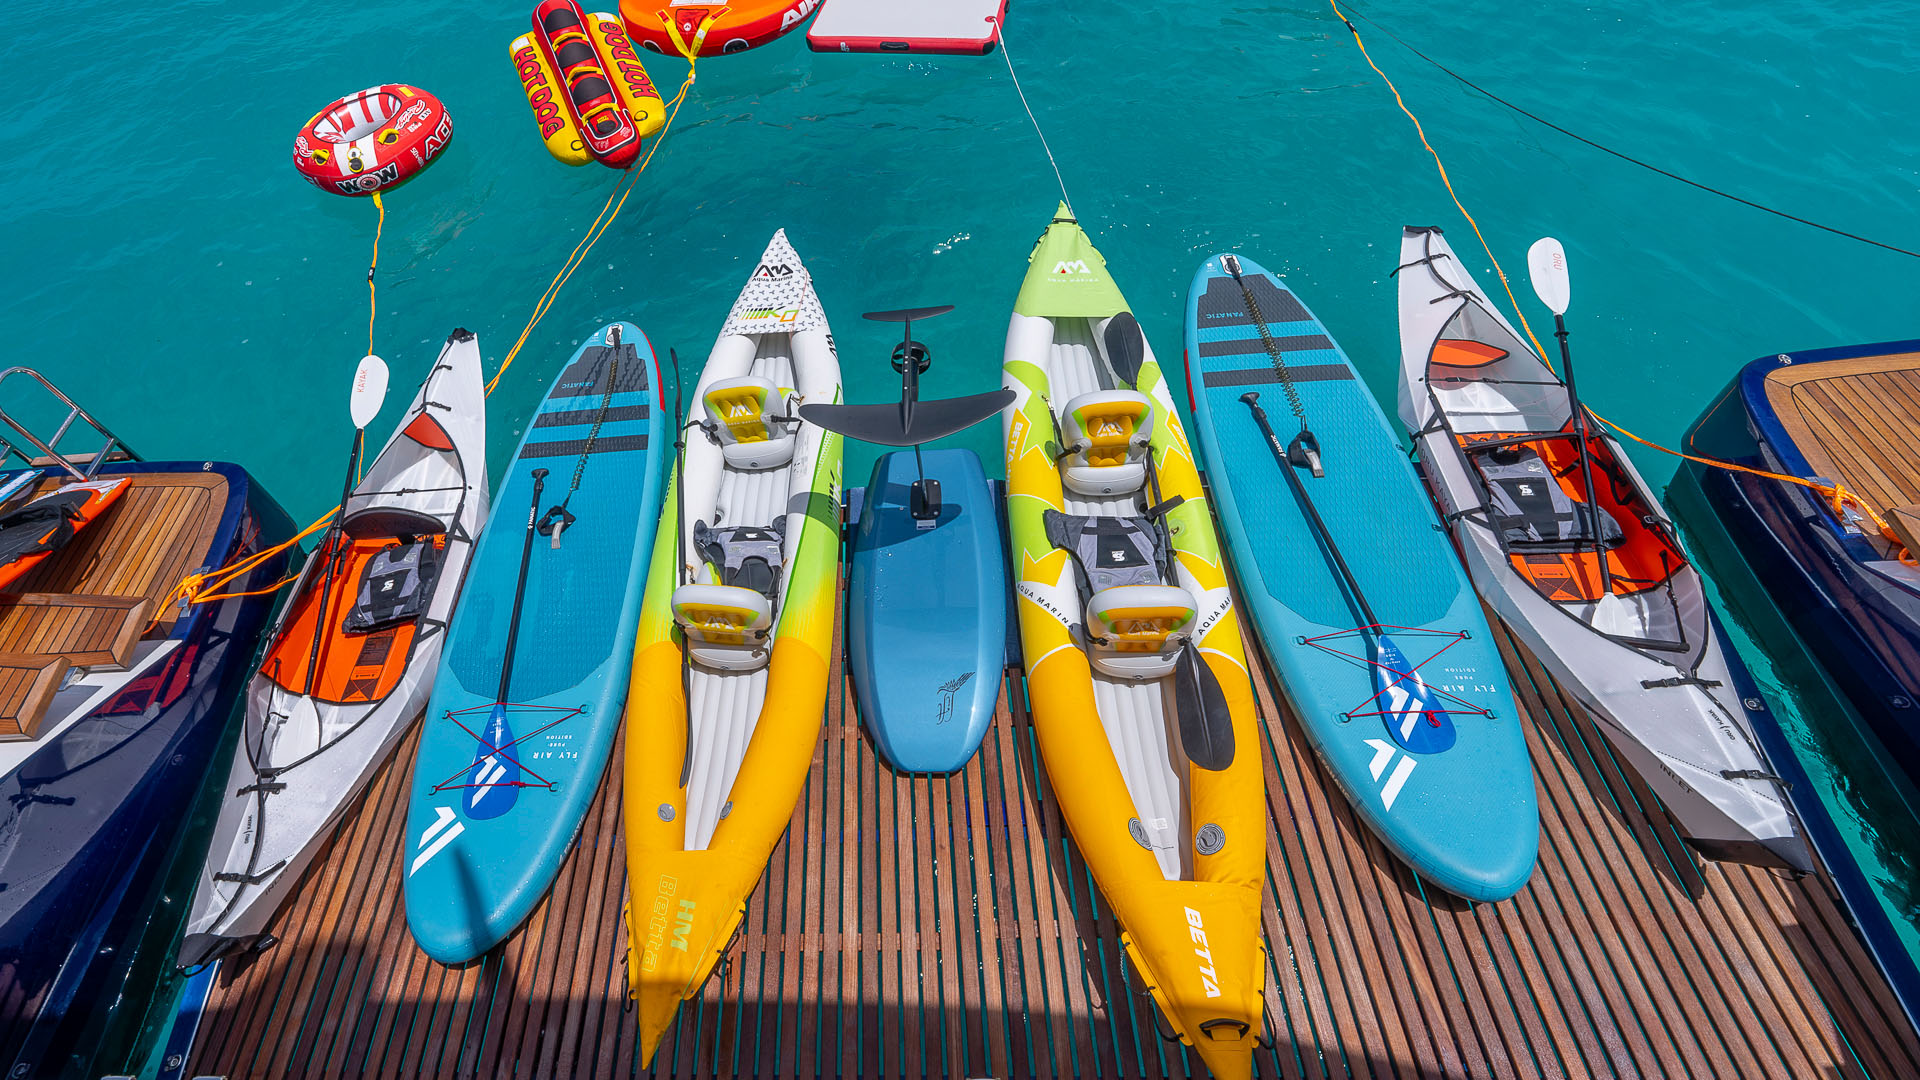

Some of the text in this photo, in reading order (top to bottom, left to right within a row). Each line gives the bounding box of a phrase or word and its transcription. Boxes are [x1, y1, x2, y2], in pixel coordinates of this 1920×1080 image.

[598, 22, 660, 100] HOT DOG
[514, 46, 565, 140] HOT DOG
[336, 162, 399, 194] WOW
[1552, 253, 1563, 271] ORU
[1206, 311, 1244, 319] FANATIC
[357, 369, 368, 393] KAYAK
[1036, 596, 1074, 631] MARINA
[1198, 610, 1221, 635] AQUA
[1442, 684, 1496, 693] FLY AIR
[533, 751, 578, 759] FLY AIR
[1659, 763, 1694, 795] INLET
[641, 873, 678, 973] Betta
[670, 899, 697, 953] HM
[1184, 906, 1222, 999] BETTA
